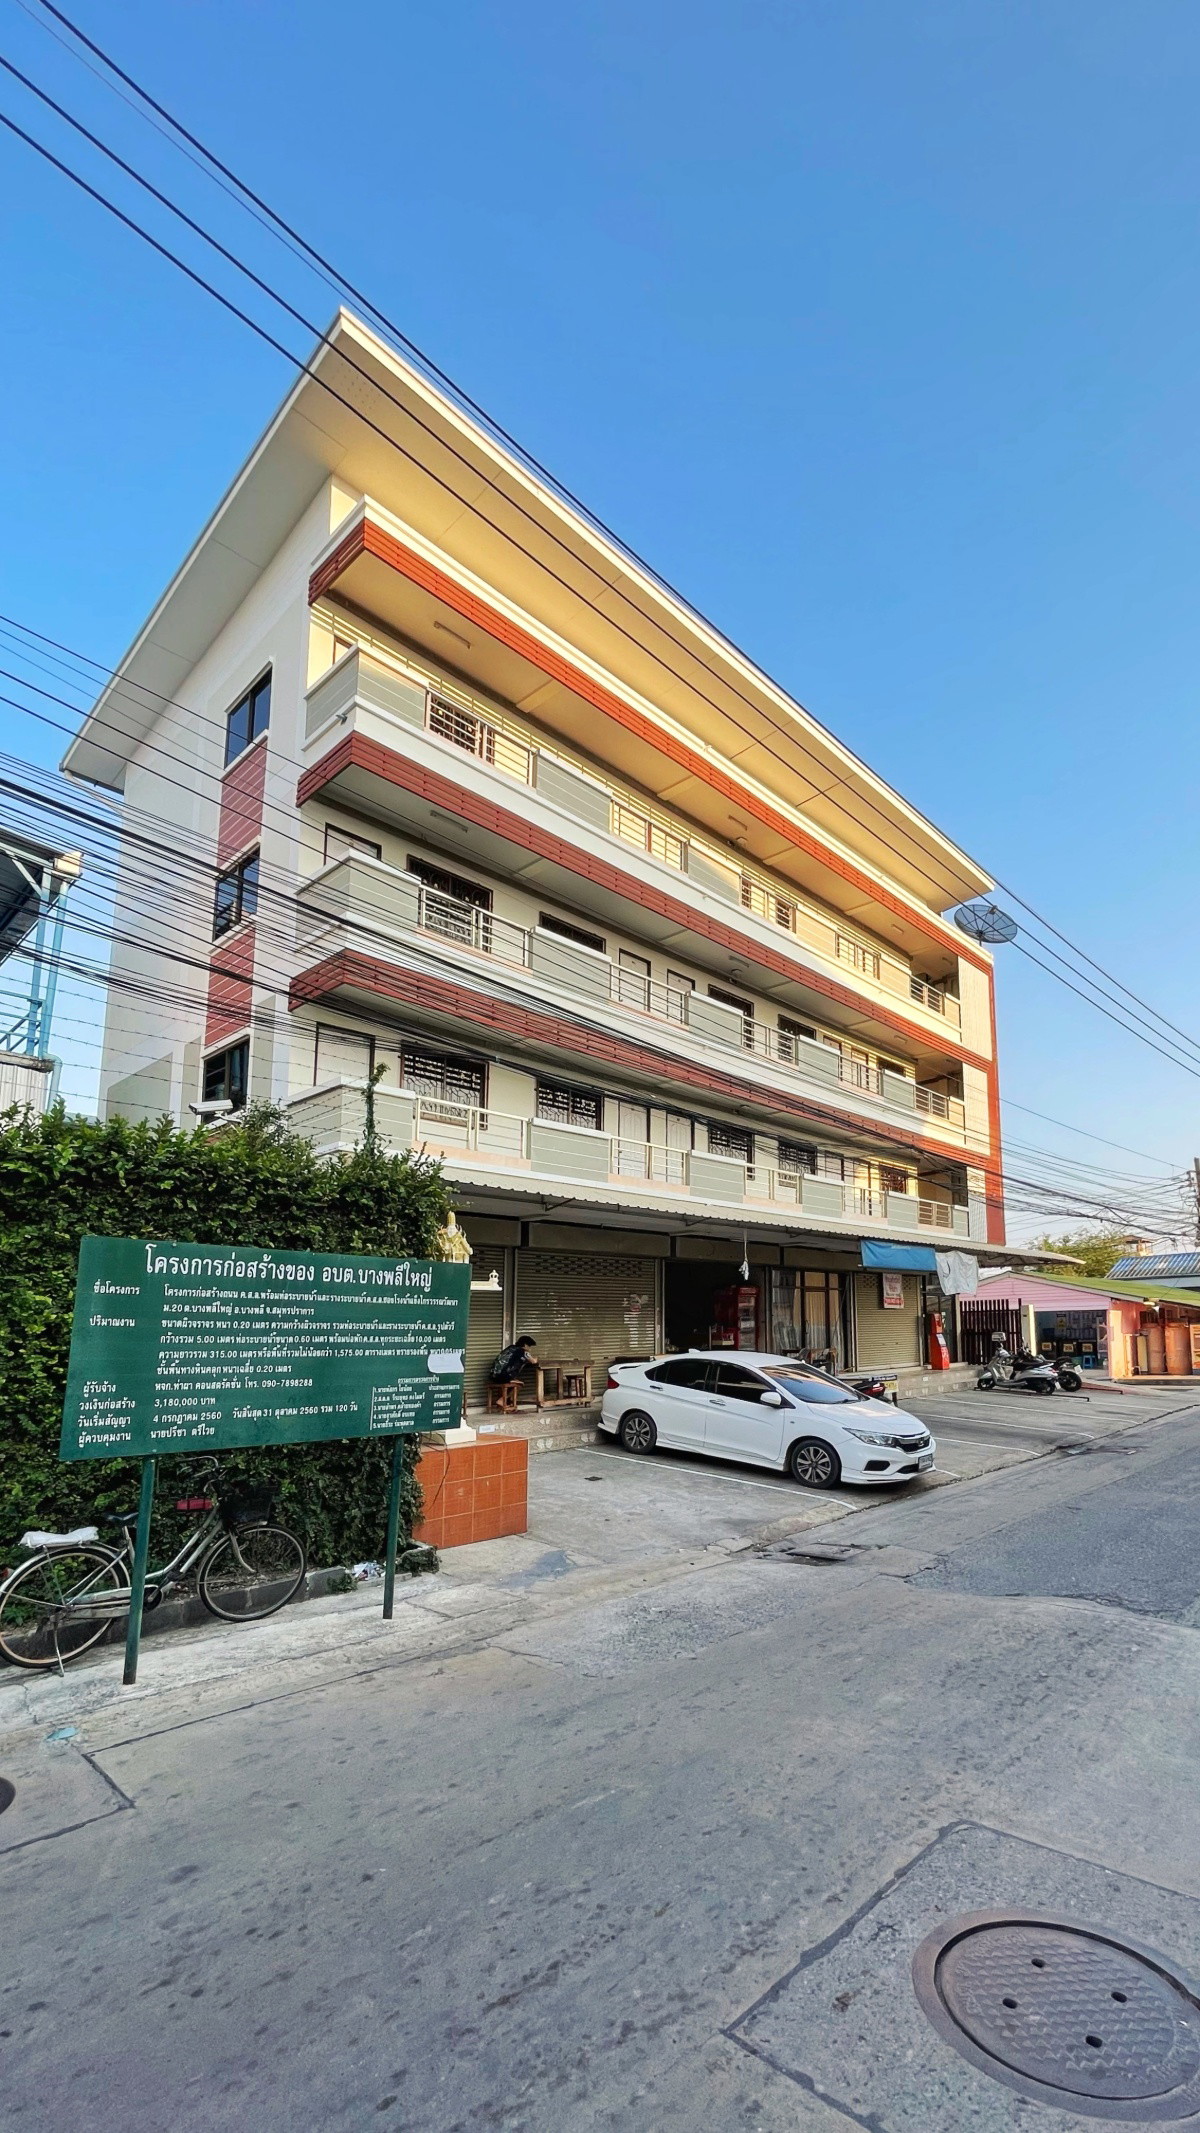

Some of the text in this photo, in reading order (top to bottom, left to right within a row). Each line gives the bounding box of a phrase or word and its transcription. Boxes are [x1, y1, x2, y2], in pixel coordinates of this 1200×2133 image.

[145, 1244, 433, 1291] โครงการก่อสร้างของ อบต.บางพลีใหญ่
[93, 1279, 140, 1295] ชื่อโครงการ
[164, 1284, 238, 1298] โครงการก่อสร้างถนน
[184, 1301, 232, 1316] ต.บางพลีใหญ่
[234, 1304, 264, 1315] อ.บางพลี
[90, 1315, 135, 1327] ปริมาณงาน
[162, 1317, 214, 1329] ขนาดผิวจราจร
[216, 1321, 230, 1329] หนา
[233, 1321, 250, 1329] 0.20
[252, 1321, 269, 1329] เมตร
[160, 1332, 194, 1343] กว้างรวม
[159, 1350, 208, 1359] ความยาวรวม
[210, 1350, 237, 1358] 315.00
[334, 1349, 363, 1357] 1,575.00
[256, 1365, 273, 1373] 0.20
[275, 1365, 292, 1373] เมตร
[83, 1381, 116, 1397] ผู้รับจ้าง
[245, 1377, 259, 1388] โทร.
[79, 1397, 136, 1410] วงเงินก่อสร้าง
[154, 1397, 216, 1407] 3,180,000 บาท
[153, 1414, 158, 1422] 4
[162, 1414, 198, 1424] กรกฎาคม
[200, 1412, 222, 1420] 2560
[263, 1408, 272, 1417] 31
[275, 1408, 298, 1419] ตุลาคม
[300, 1406, 318, 1414] 2560
[335, 1404, 348, 1412] 120
[349, 1401, 358, 1411] วัน
[78, 1412, 130, 1428] วันเริ่มสัญญา
[150, 1426, 186, 1438] นายปรีชา
[78, 1432, 131, 1448] ผู้ควบคุมงาน
